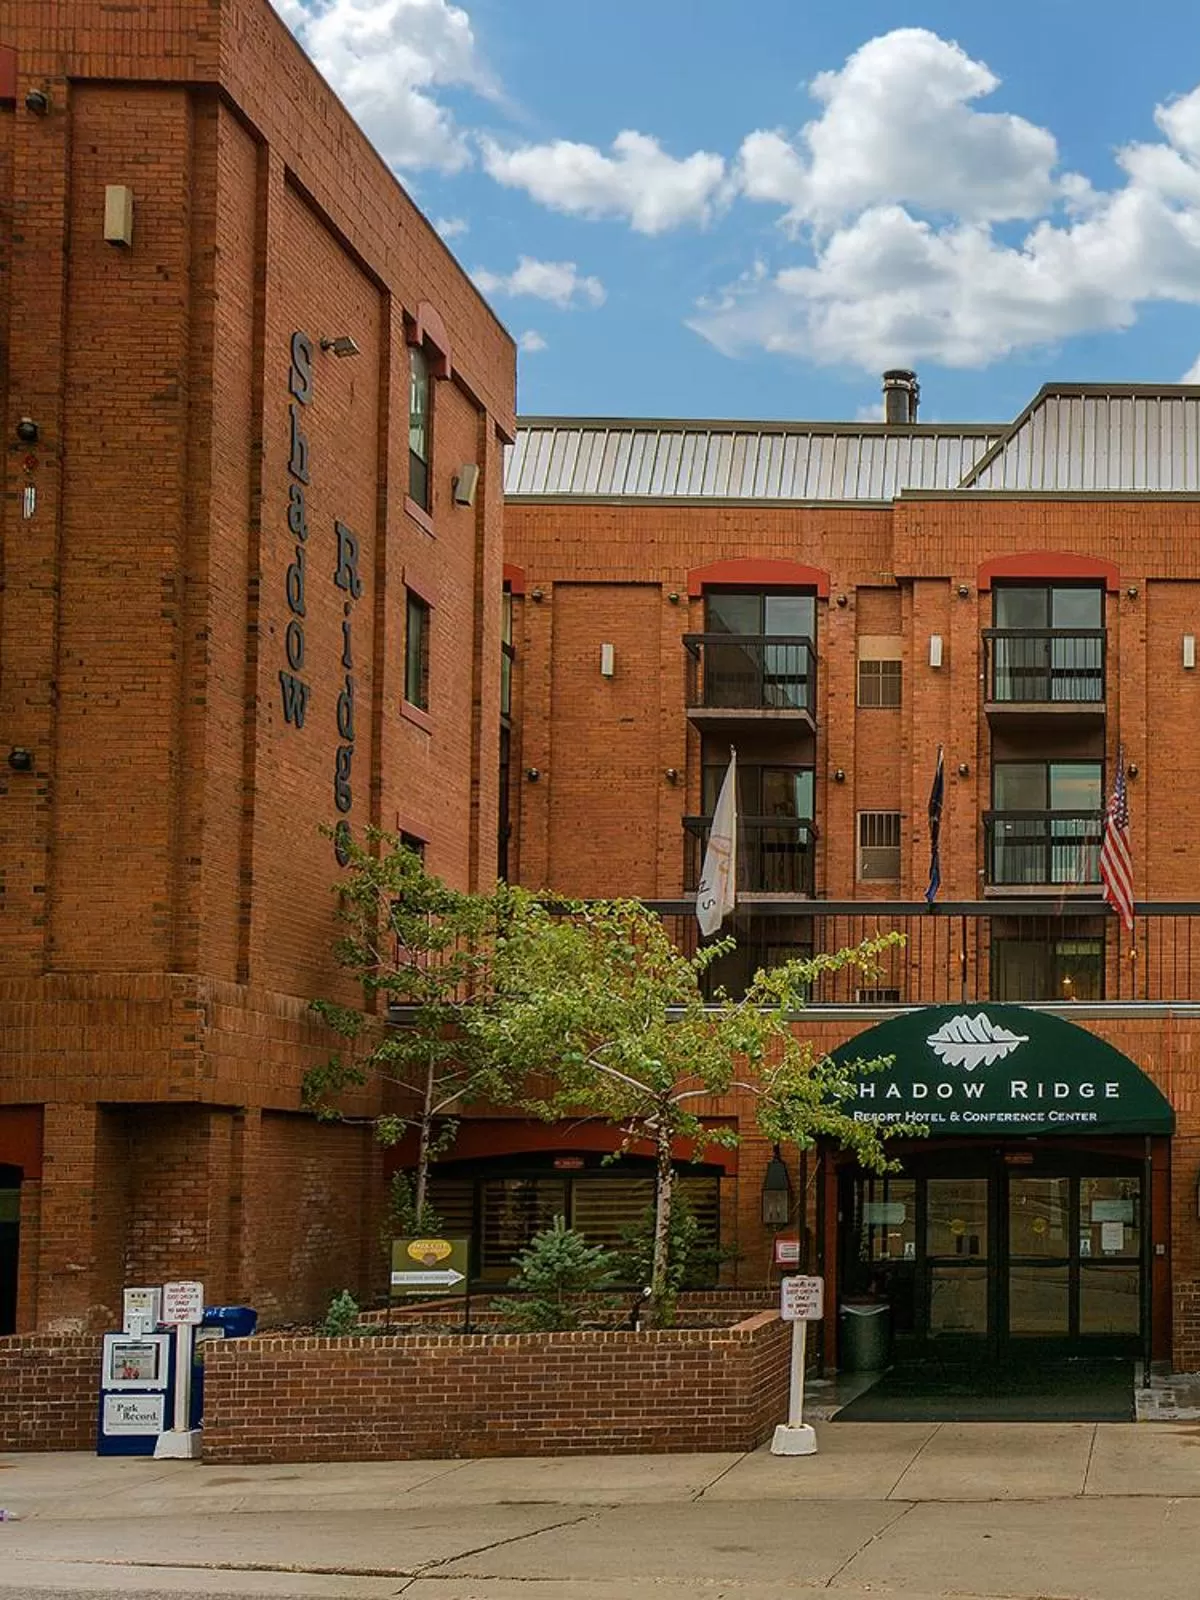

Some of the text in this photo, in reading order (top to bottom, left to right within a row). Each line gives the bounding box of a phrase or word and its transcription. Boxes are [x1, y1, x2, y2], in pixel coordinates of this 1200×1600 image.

[858, 1080, 1120, 1099] HADOW RIDGE
[905, 1111, 946, 1122] HOTEL
[949, 1111, 960, 1122] &
[962, 1111, 1045, 1122] CONFERENCE
[1048, 1111, 1097, 1122] CENTER
[116, 1404, 138, 1412] Park
